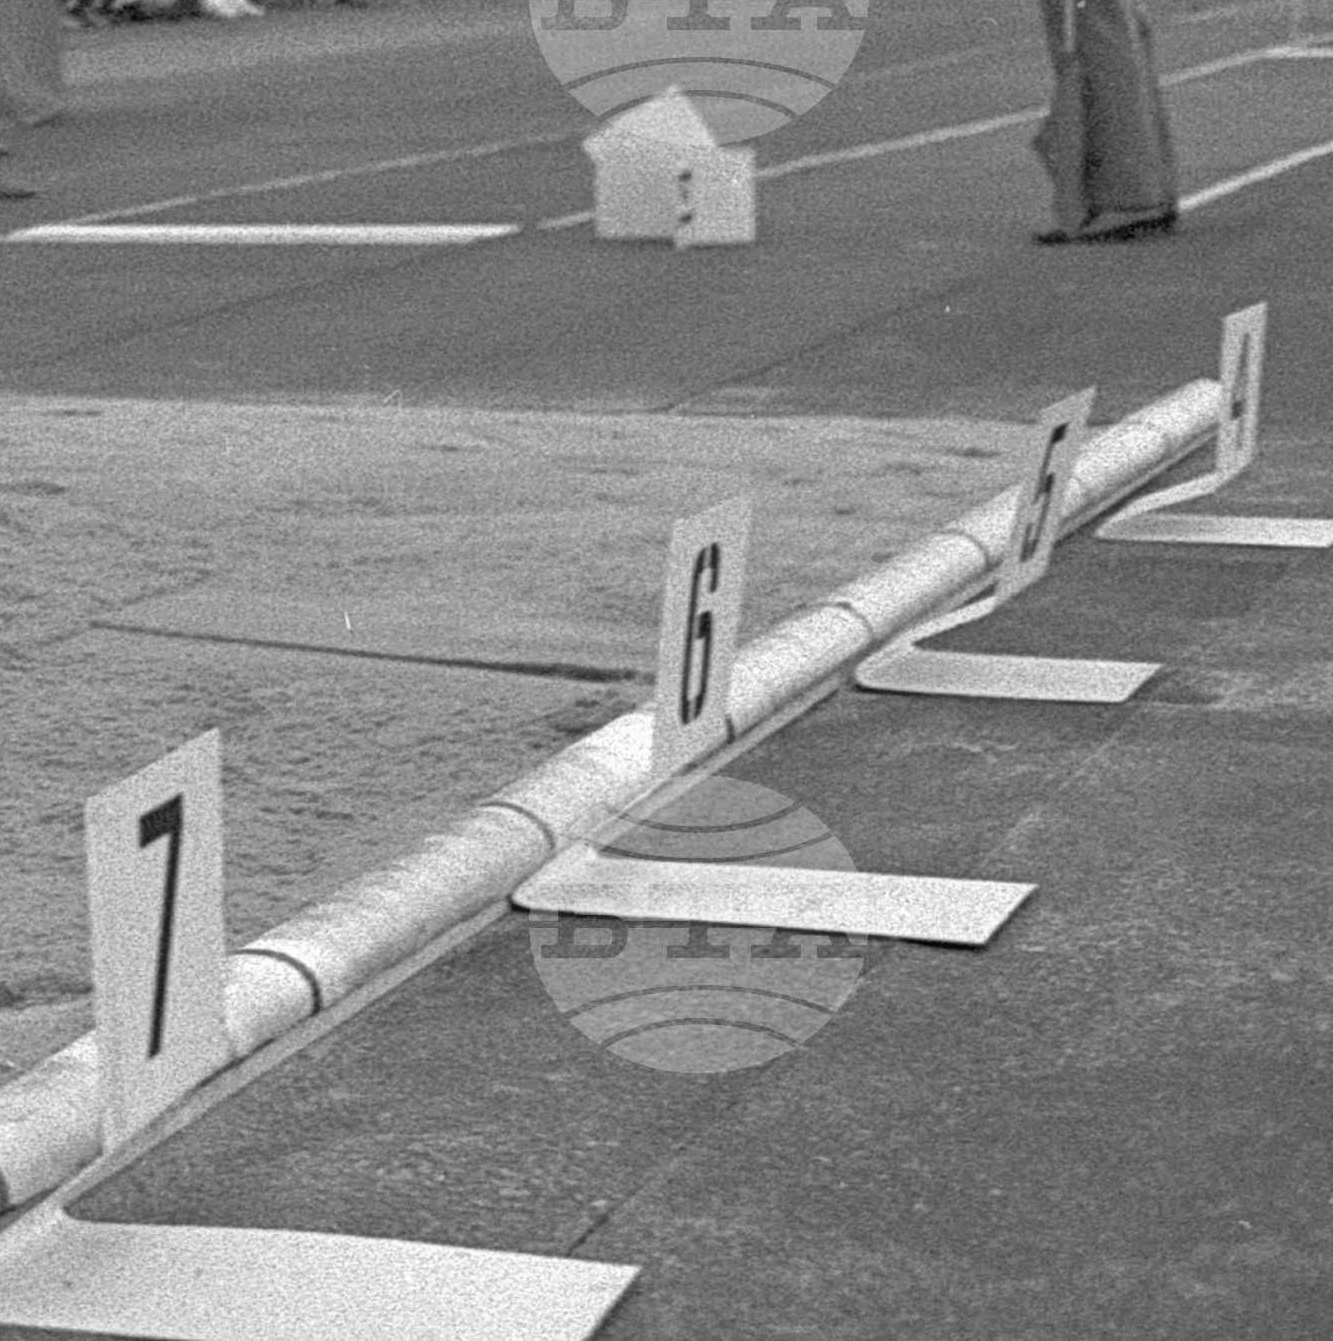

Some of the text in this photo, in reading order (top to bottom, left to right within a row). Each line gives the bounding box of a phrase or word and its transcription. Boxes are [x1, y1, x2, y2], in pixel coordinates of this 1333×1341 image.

[1020, 422, 1068, 563] 5
[681, 541, 721, 725] 6
[139, 794, 183, 1057] 7
